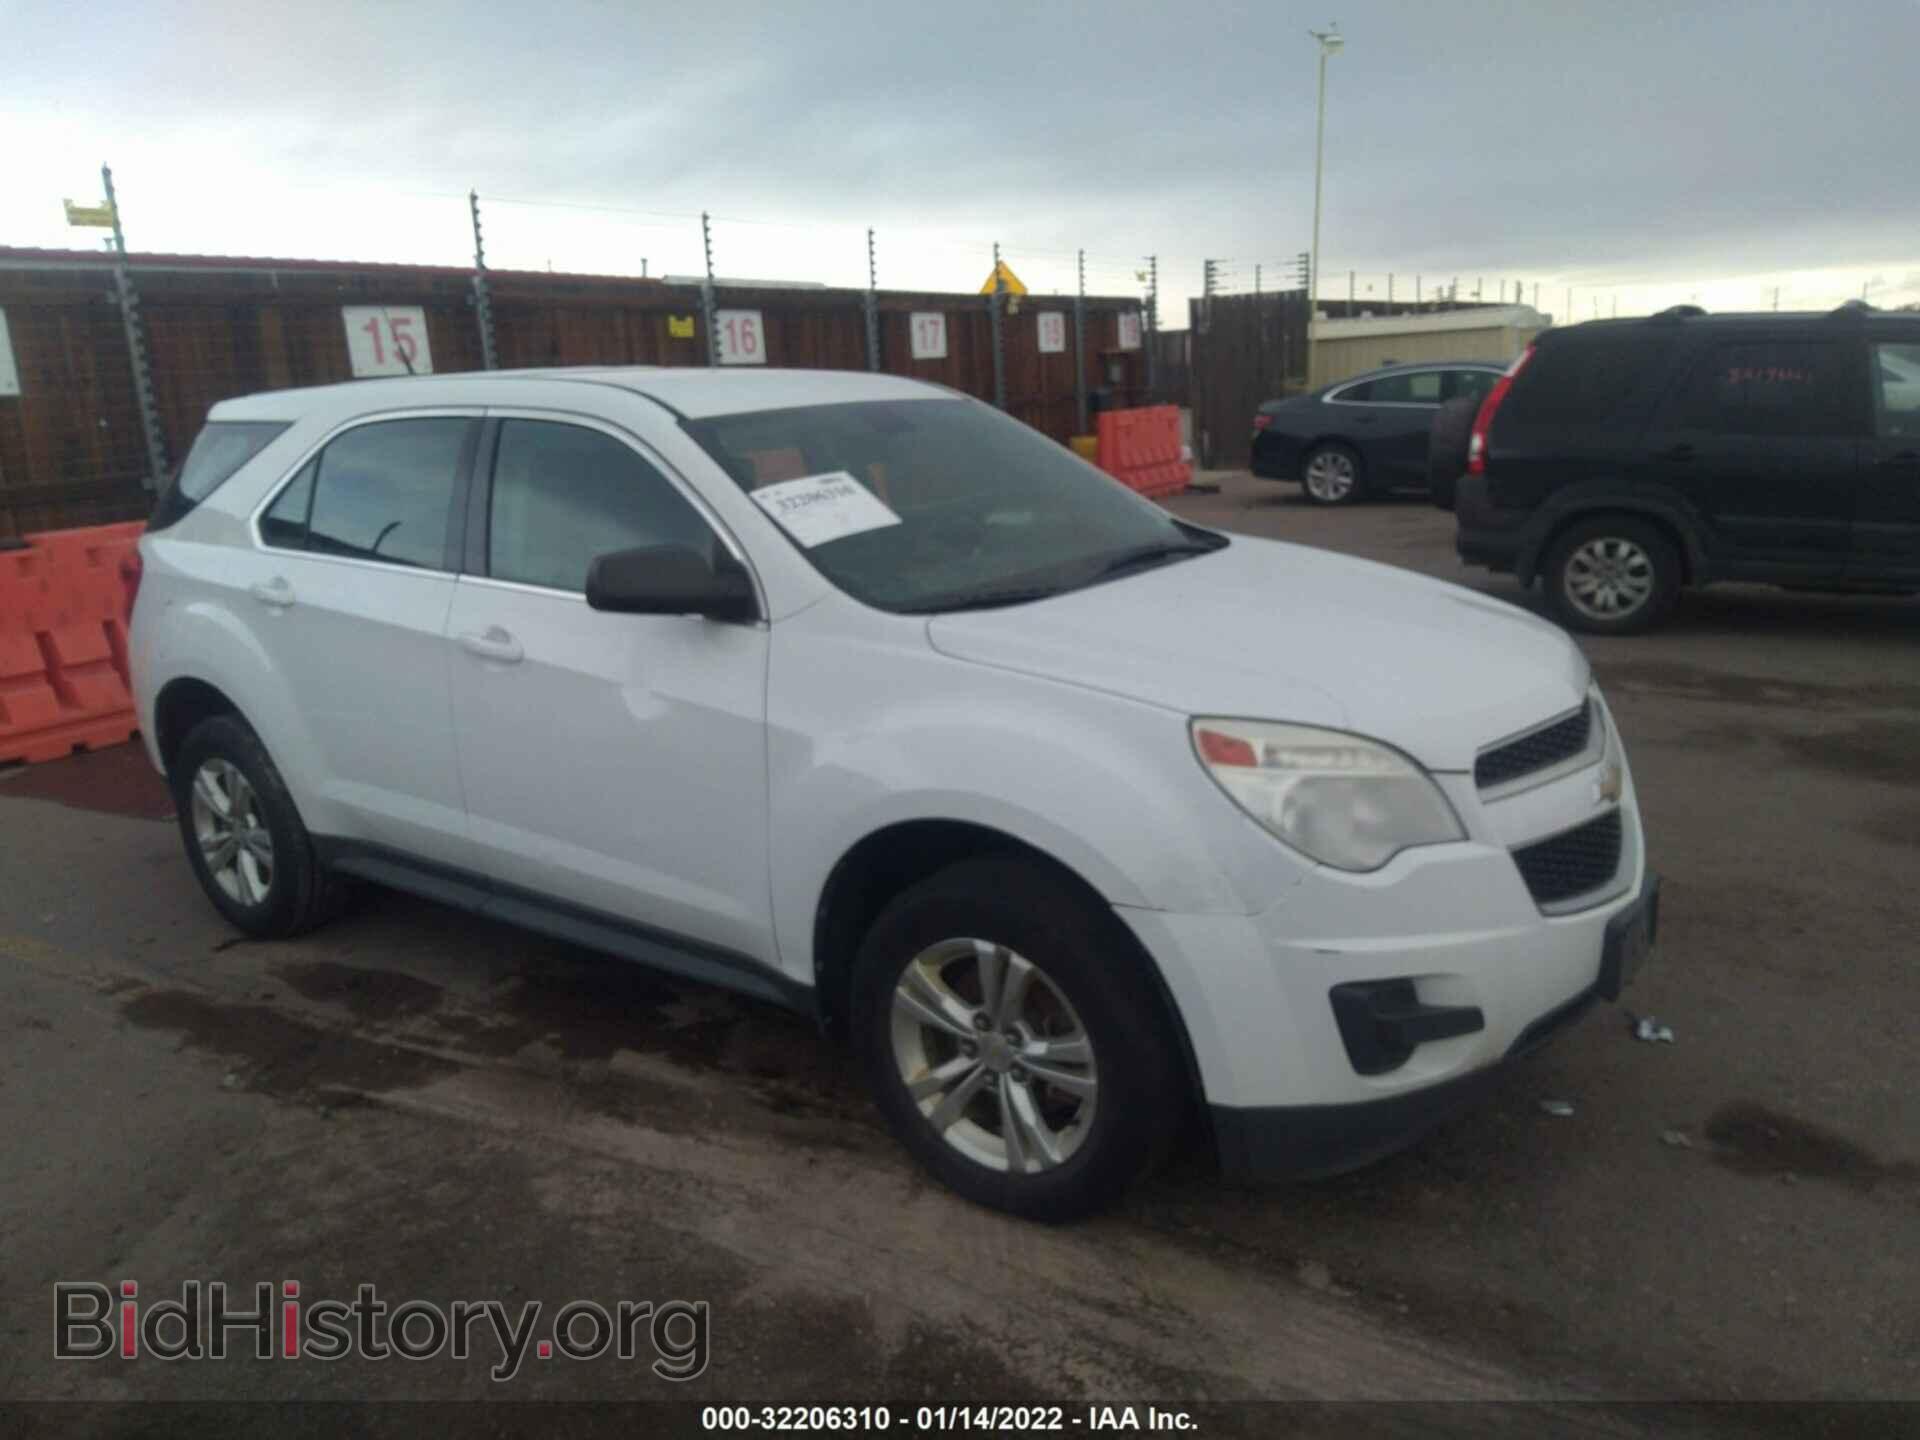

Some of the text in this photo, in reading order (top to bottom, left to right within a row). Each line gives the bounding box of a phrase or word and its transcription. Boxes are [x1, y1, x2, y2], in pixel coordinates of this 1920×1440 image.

[363, 316, 417, 364] 15
[725, 318, 757, 354] 16
[918, 319, 941, 352] 17
